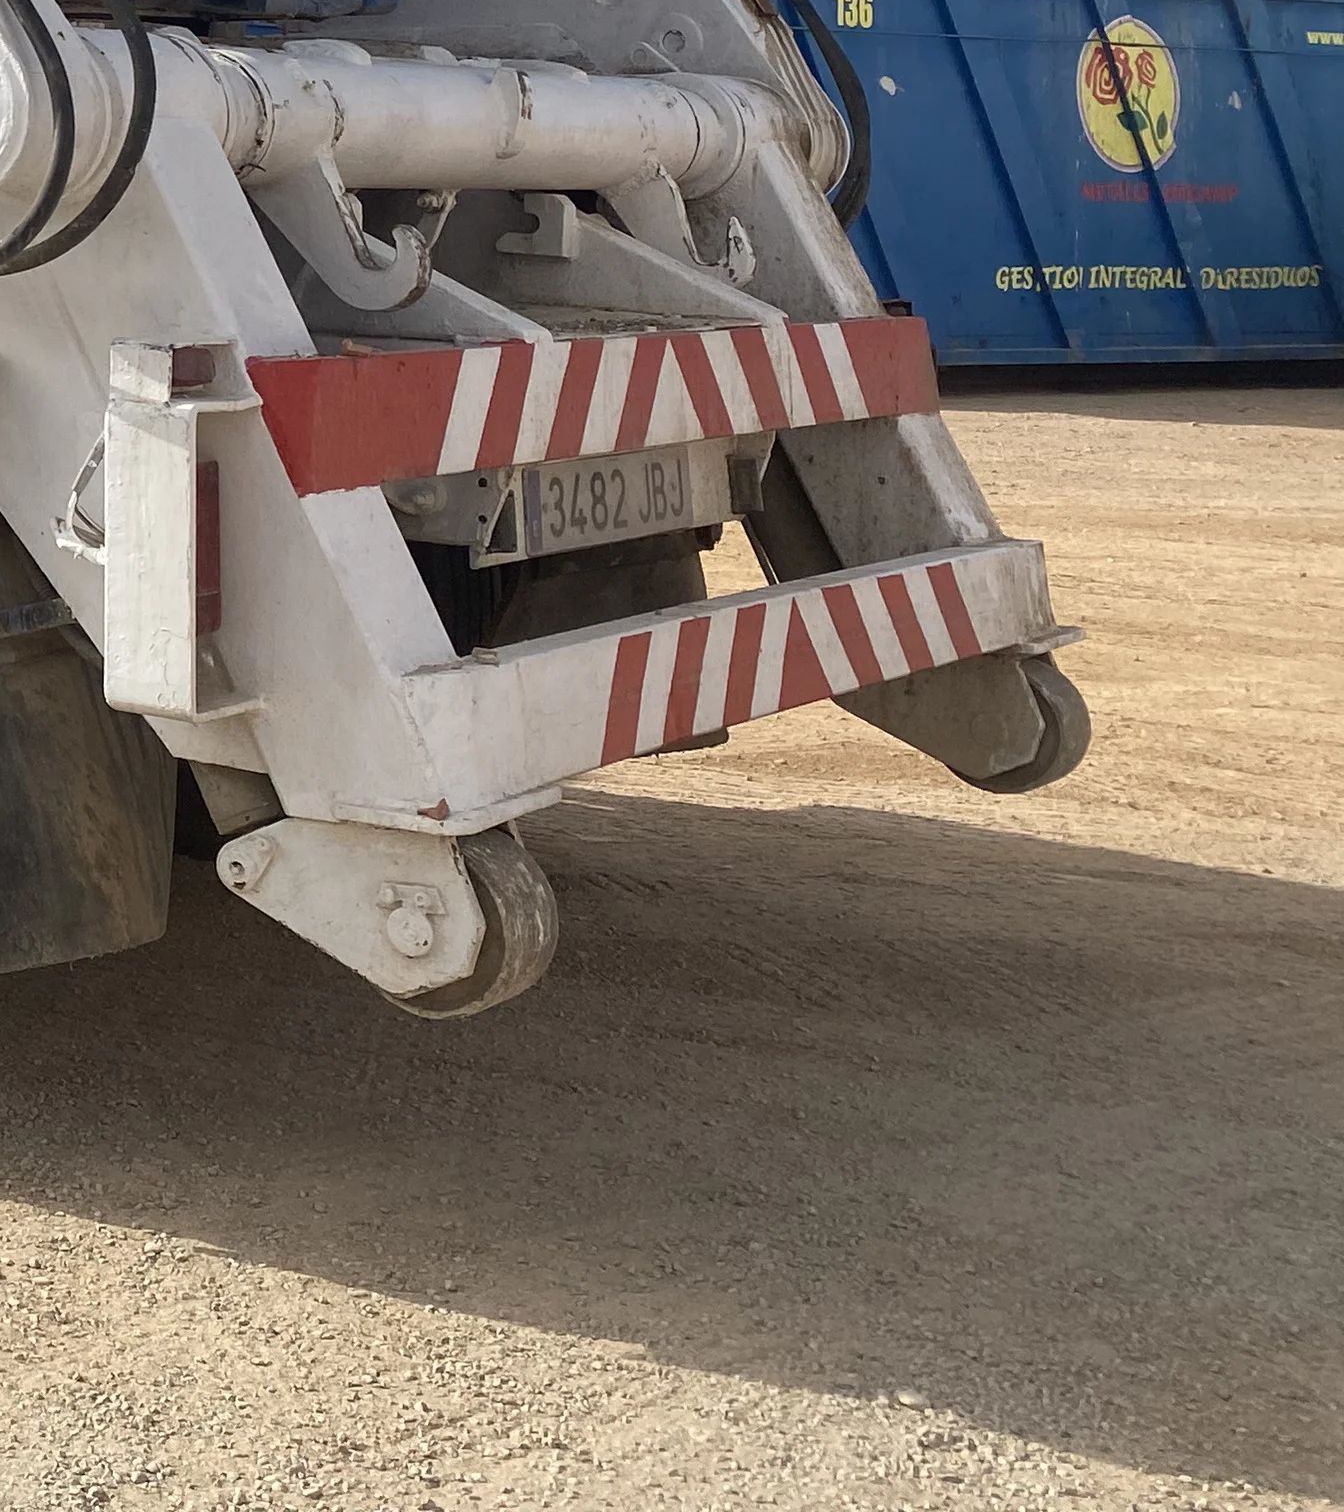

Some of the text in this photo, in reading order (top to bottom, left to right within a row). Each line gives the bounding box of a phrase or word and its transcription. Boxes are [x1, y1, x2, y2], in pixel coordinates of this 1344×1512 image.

[1088, 265, 1190, 291] INTEGRAL
[1221, 265, 1322, 290] RESIDUOS
[549, 458, 684, 537] 3482 JBJ
